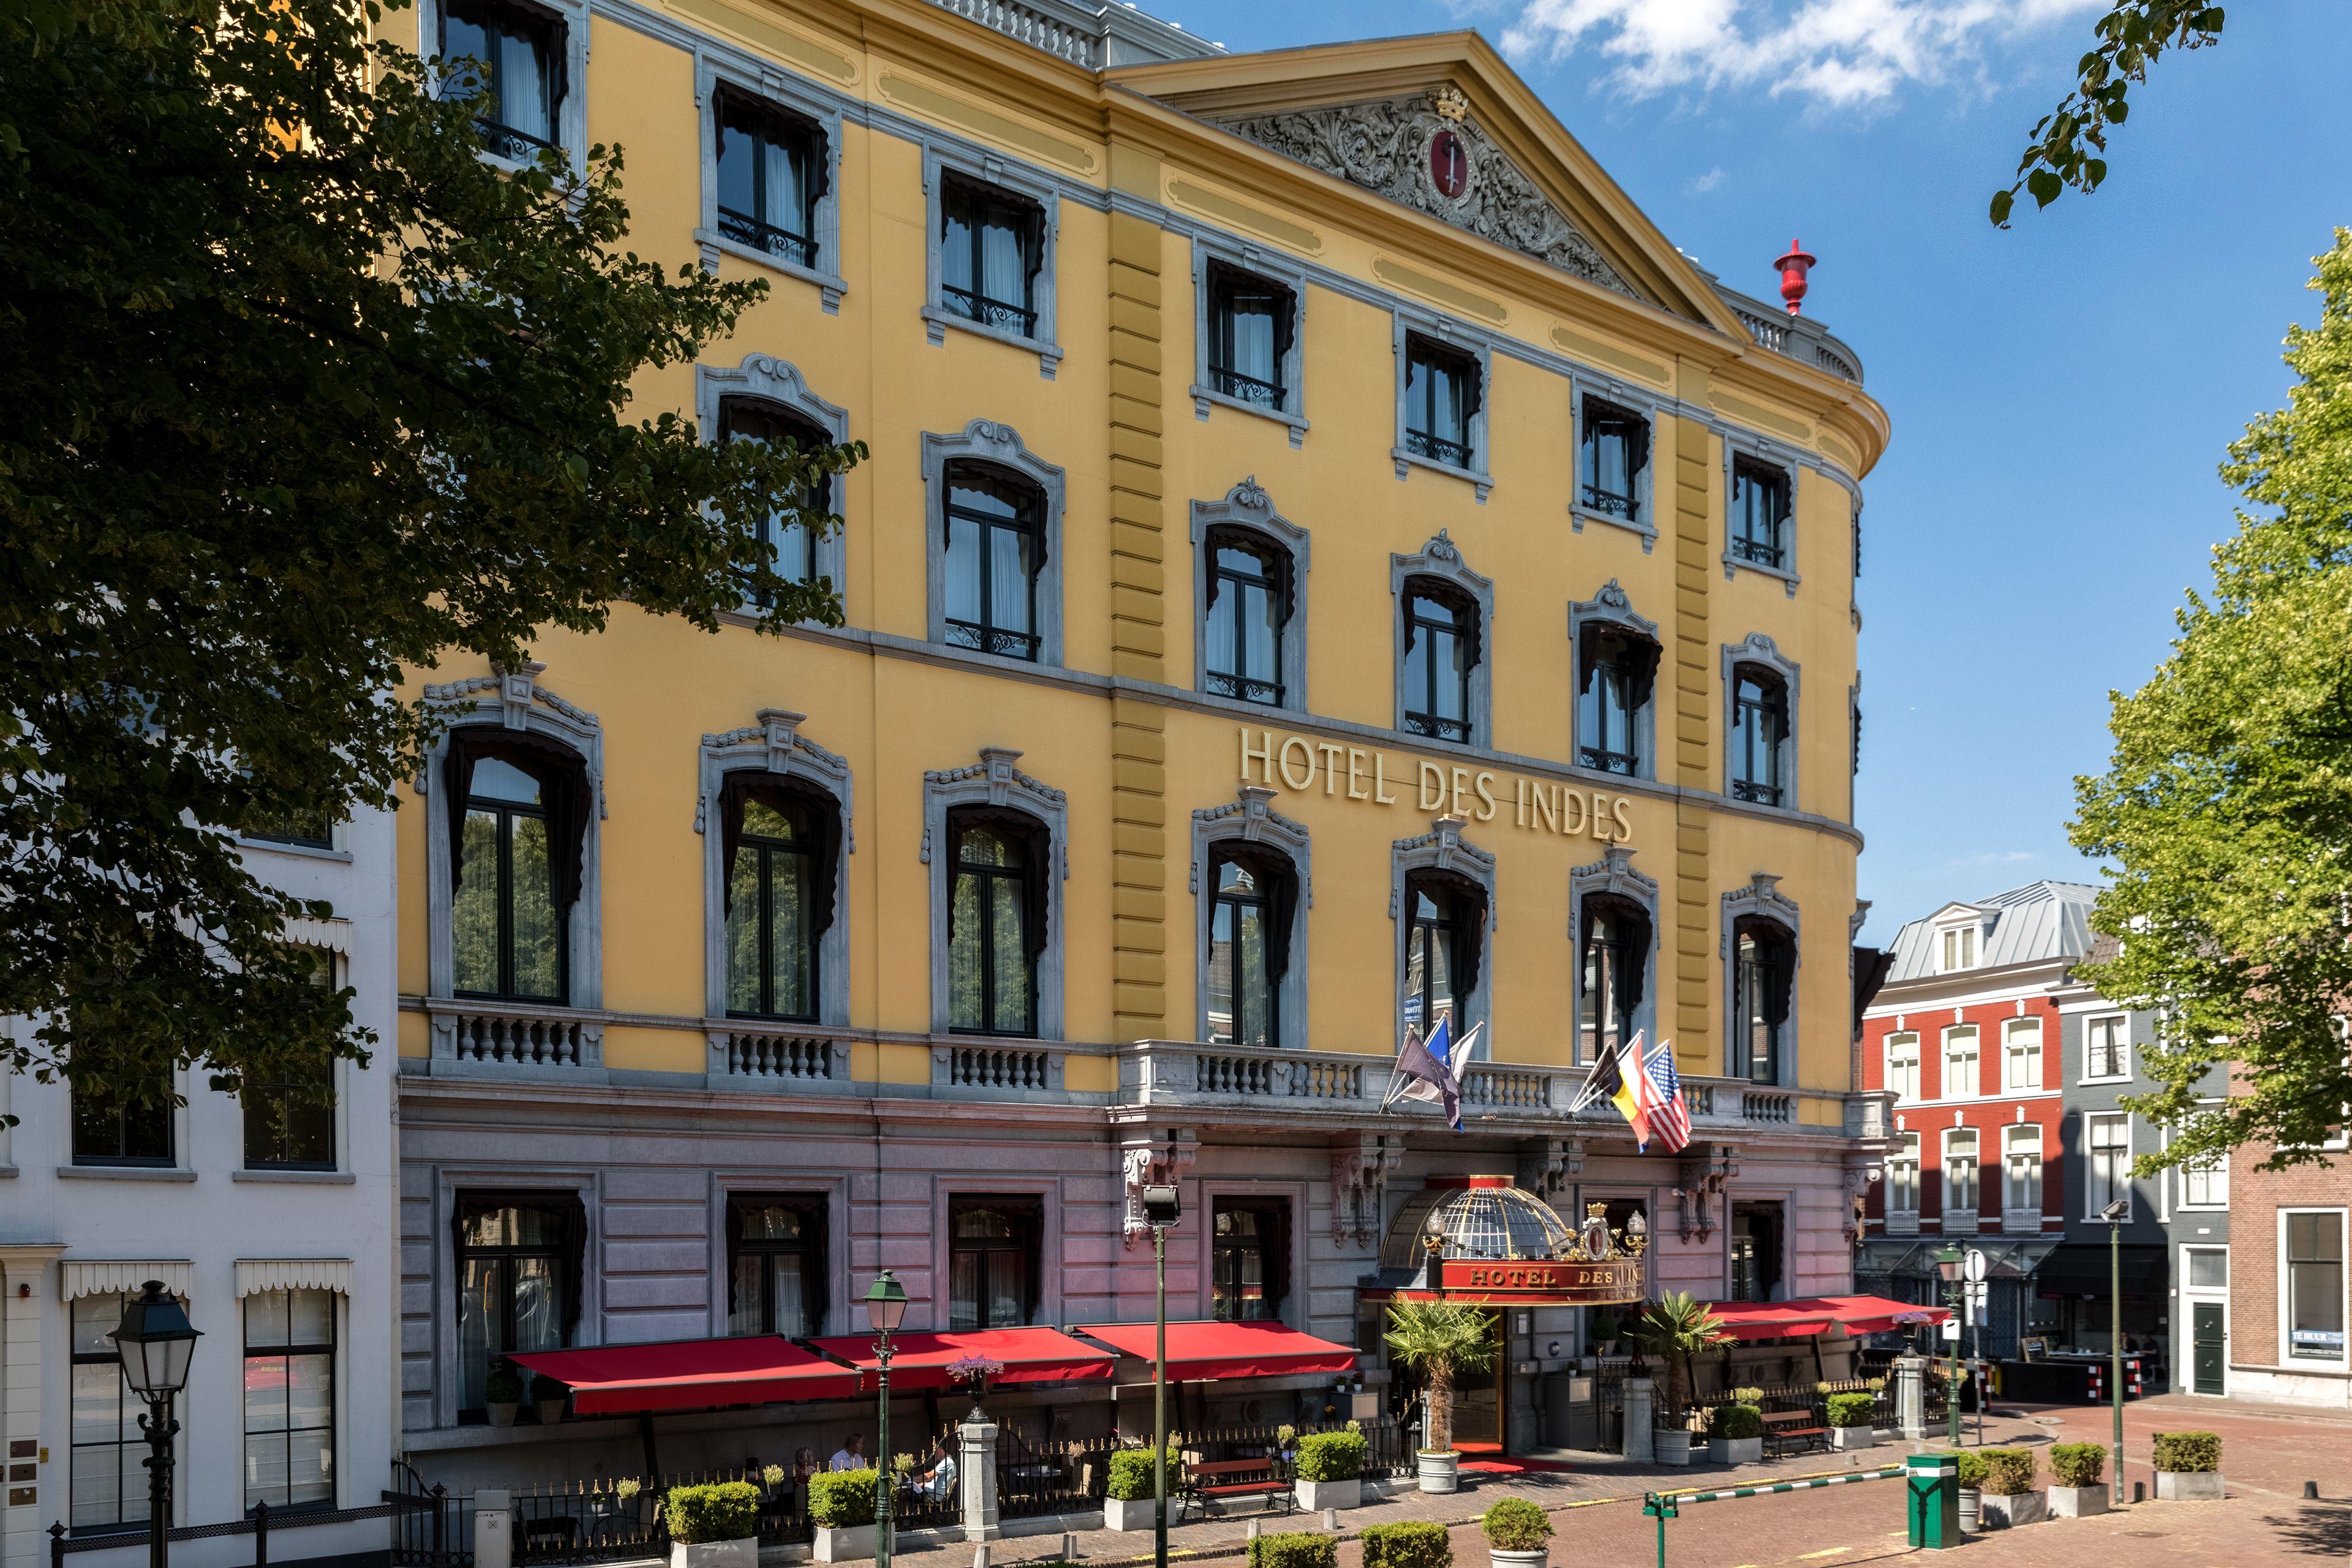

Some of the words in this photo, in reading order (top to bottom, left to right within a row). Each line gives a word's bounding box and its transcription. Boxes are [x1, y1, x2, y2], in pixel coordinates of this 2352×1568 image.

[1239, 726, 1396, 805] HOTEL
[1418, 760, 1497, 821] DES
[1515, 778, 1632, 843] INDES
[1471, 1269, 1556, 1285] HOTEL
[1579, 1271, 1613, 1284] DES
[2292, 1332, 2303, 1340] TE
